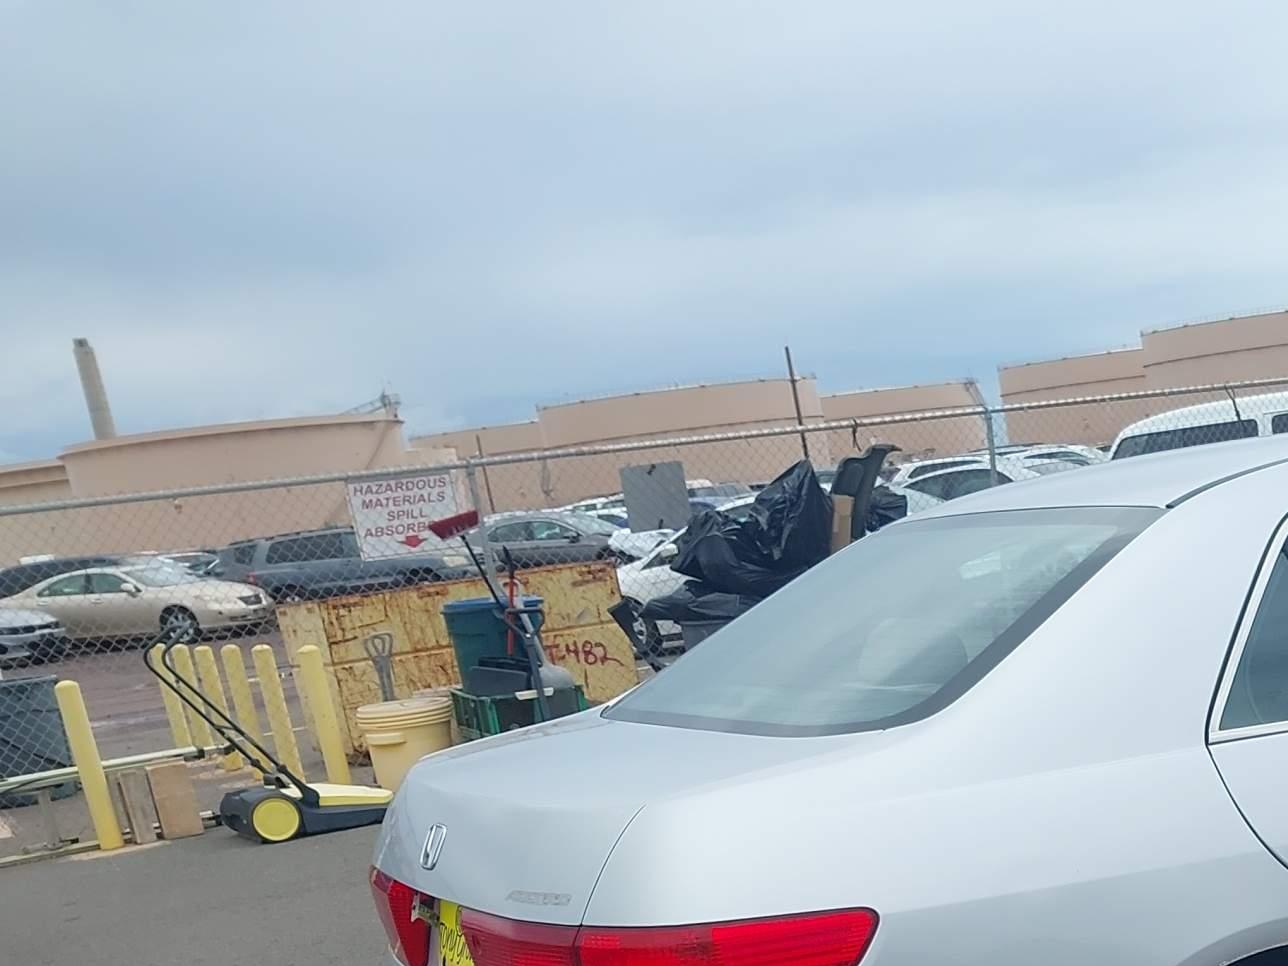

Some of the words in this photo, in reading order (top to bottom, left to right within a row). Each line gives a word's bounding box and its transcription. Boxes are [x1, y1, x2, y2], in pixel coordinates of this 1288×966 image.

[353, 477, 447, 496] HAZARDOUS
[362, 491, 446, 509] MATERIALS
[387, 507, 428, 522] SPILL
[363, 521, 432, 538] ABSORB
